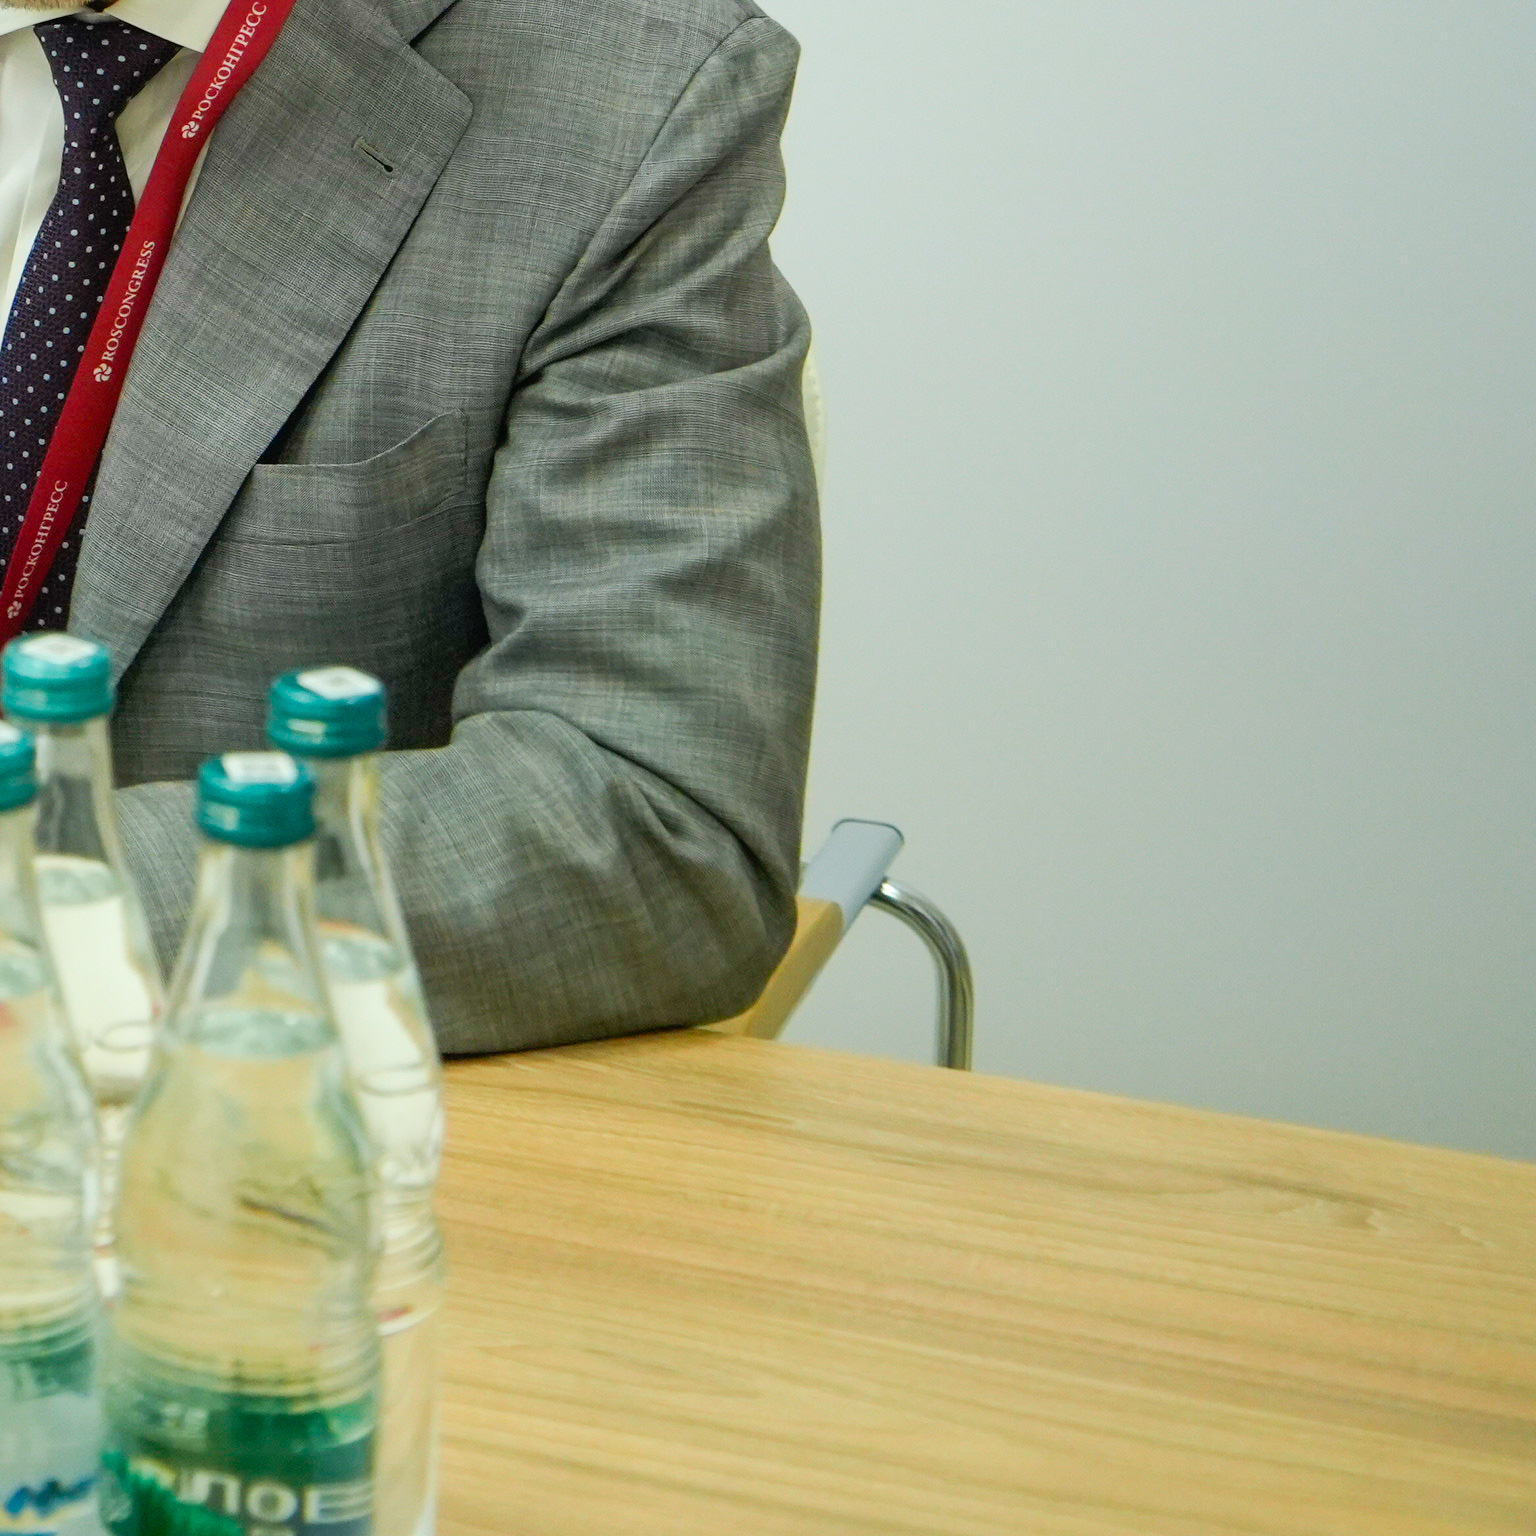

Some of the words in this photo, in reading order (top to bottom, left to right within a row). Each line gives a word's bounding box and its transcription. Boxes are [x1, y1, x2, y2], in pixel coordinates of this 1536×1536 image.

[193, 1, 267, 121] РОСКОНГРЕСС
[101, 240, 157, 363] ROSCONGRESS
[14, 480, 69, 600] РОСКОНГРЕСС
